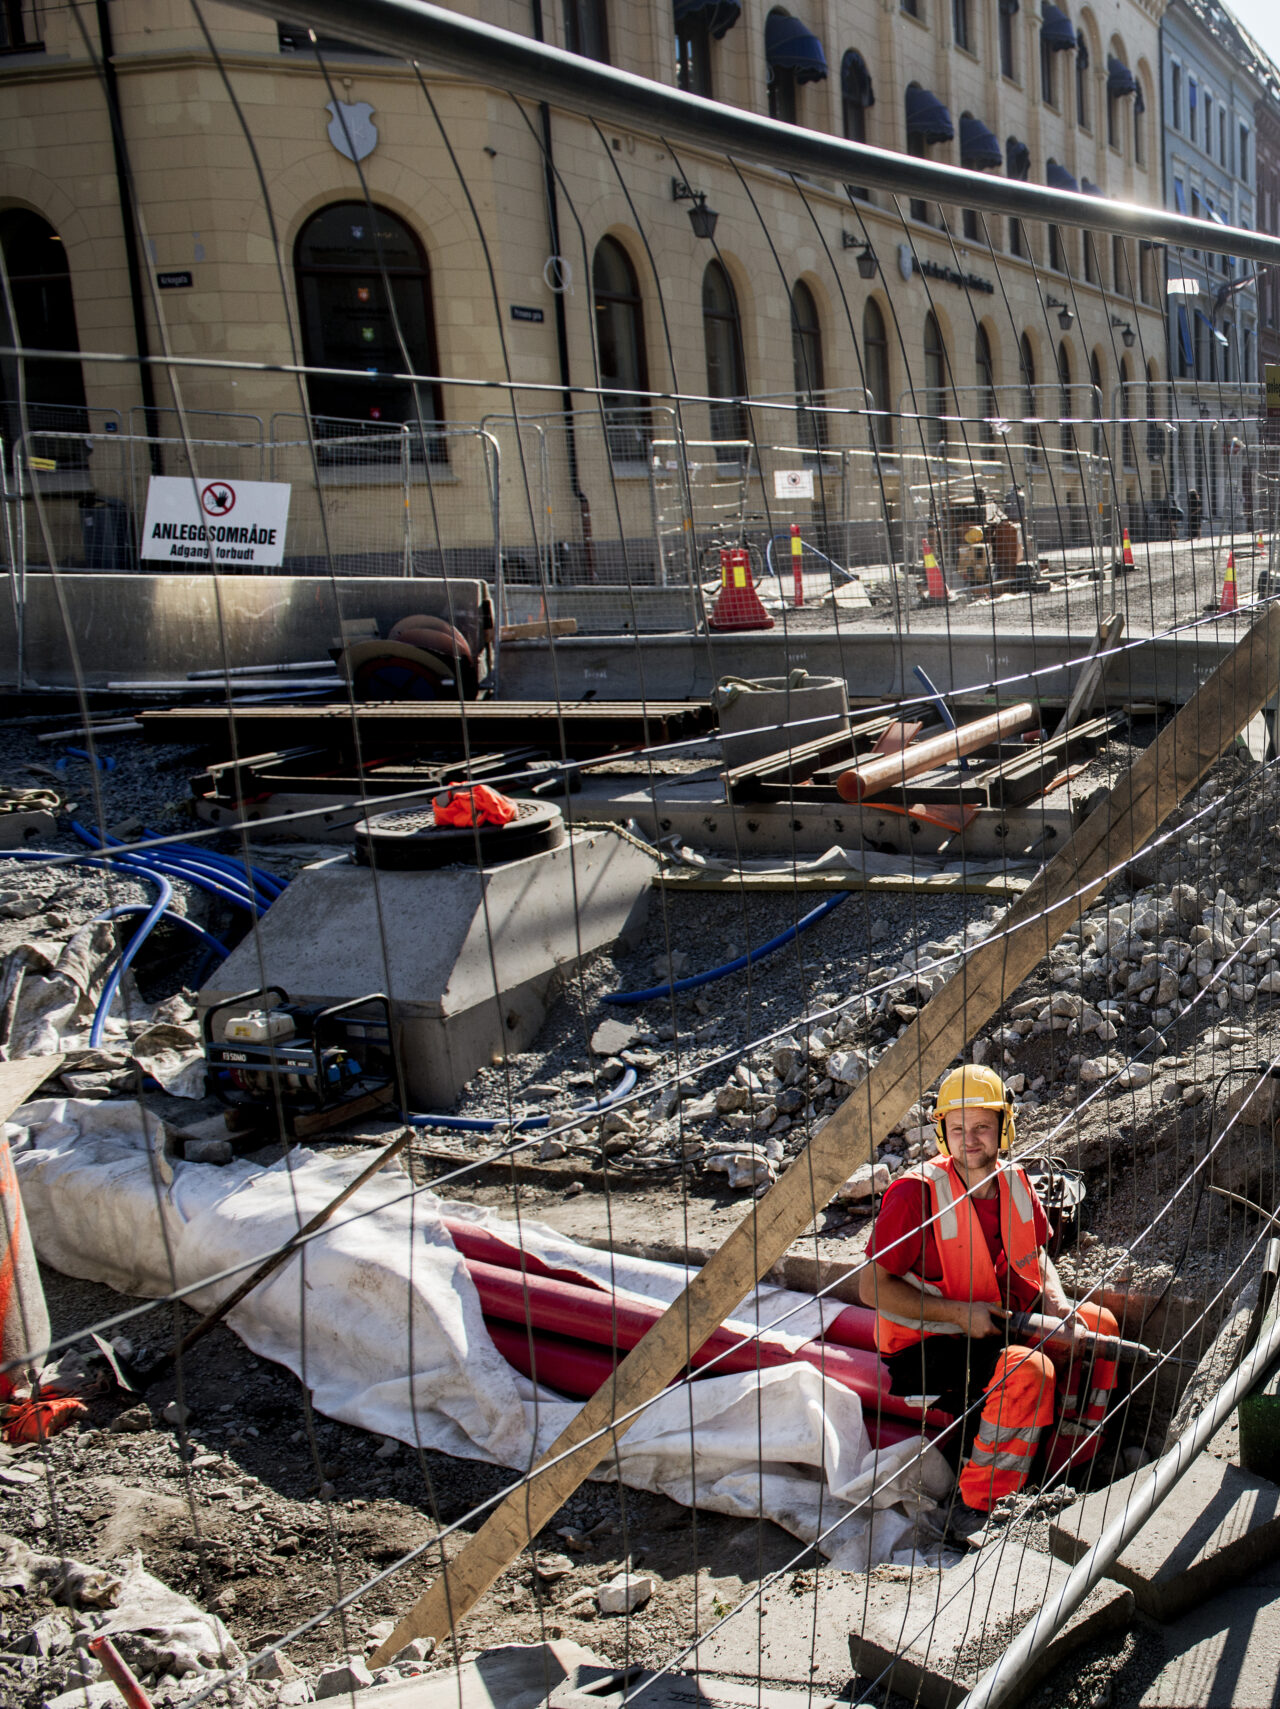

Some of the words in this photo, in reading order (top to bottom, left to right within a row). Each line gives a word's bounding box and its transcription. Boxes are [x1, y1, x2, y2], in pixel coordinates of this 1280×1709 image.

[152, 522, 277, 545] ANLEGGSOMRÅDE
[170, 544, 209, 559] Adgang
[216, 546, 255, 560] forbudt
